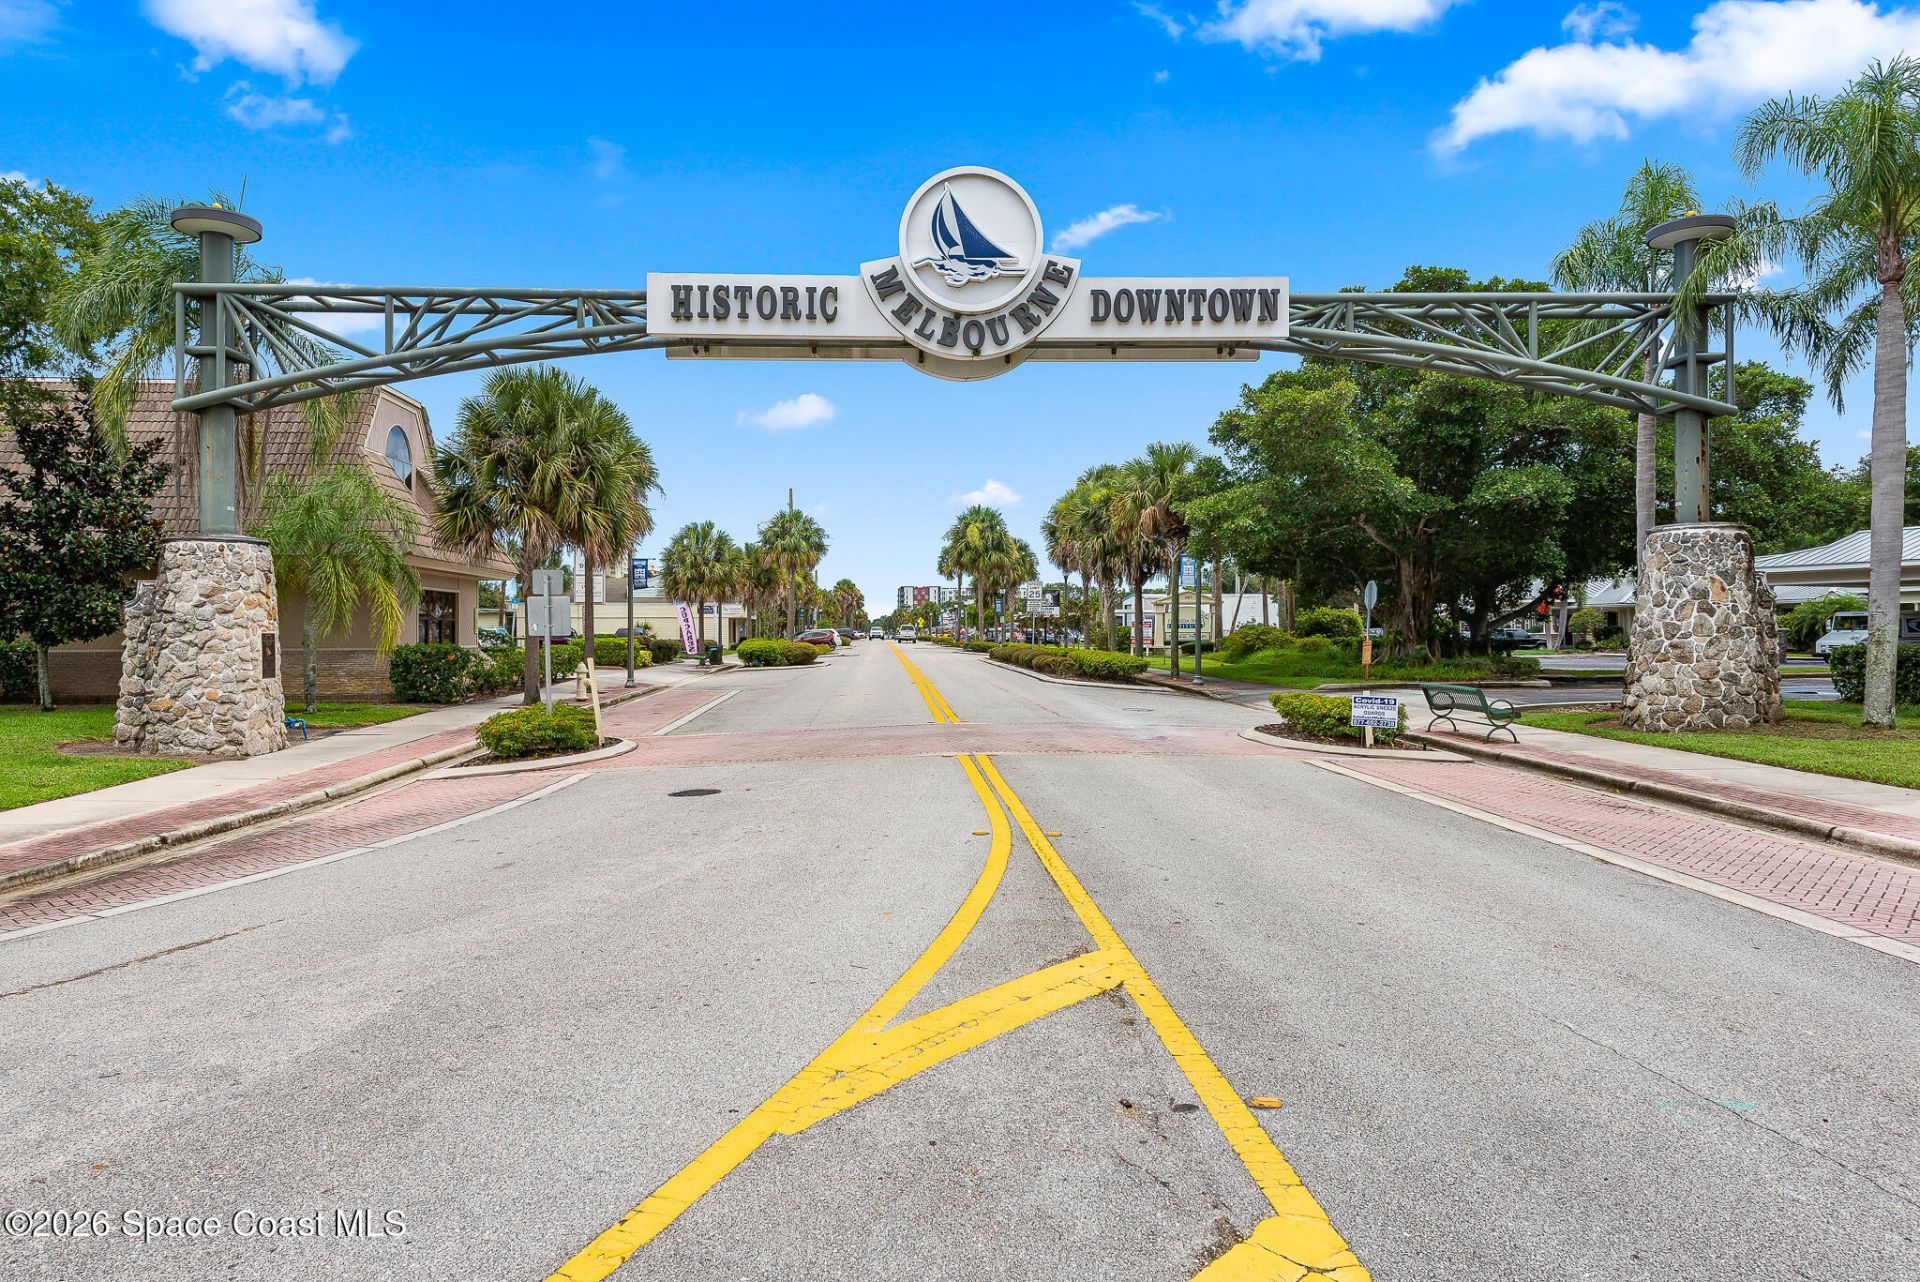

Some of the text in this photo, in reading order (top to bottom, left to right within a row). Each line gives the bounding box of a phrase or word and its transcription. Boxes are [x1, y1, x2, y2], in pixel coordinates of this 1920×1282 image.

[670, 284, 839, 323] HISTORIC
[870, 259, 1074, 350] MELBOURNE
[1090, 287, 1281, 324] DOWNTOWN
[1355, 697, 1395, 705] Covid-19
